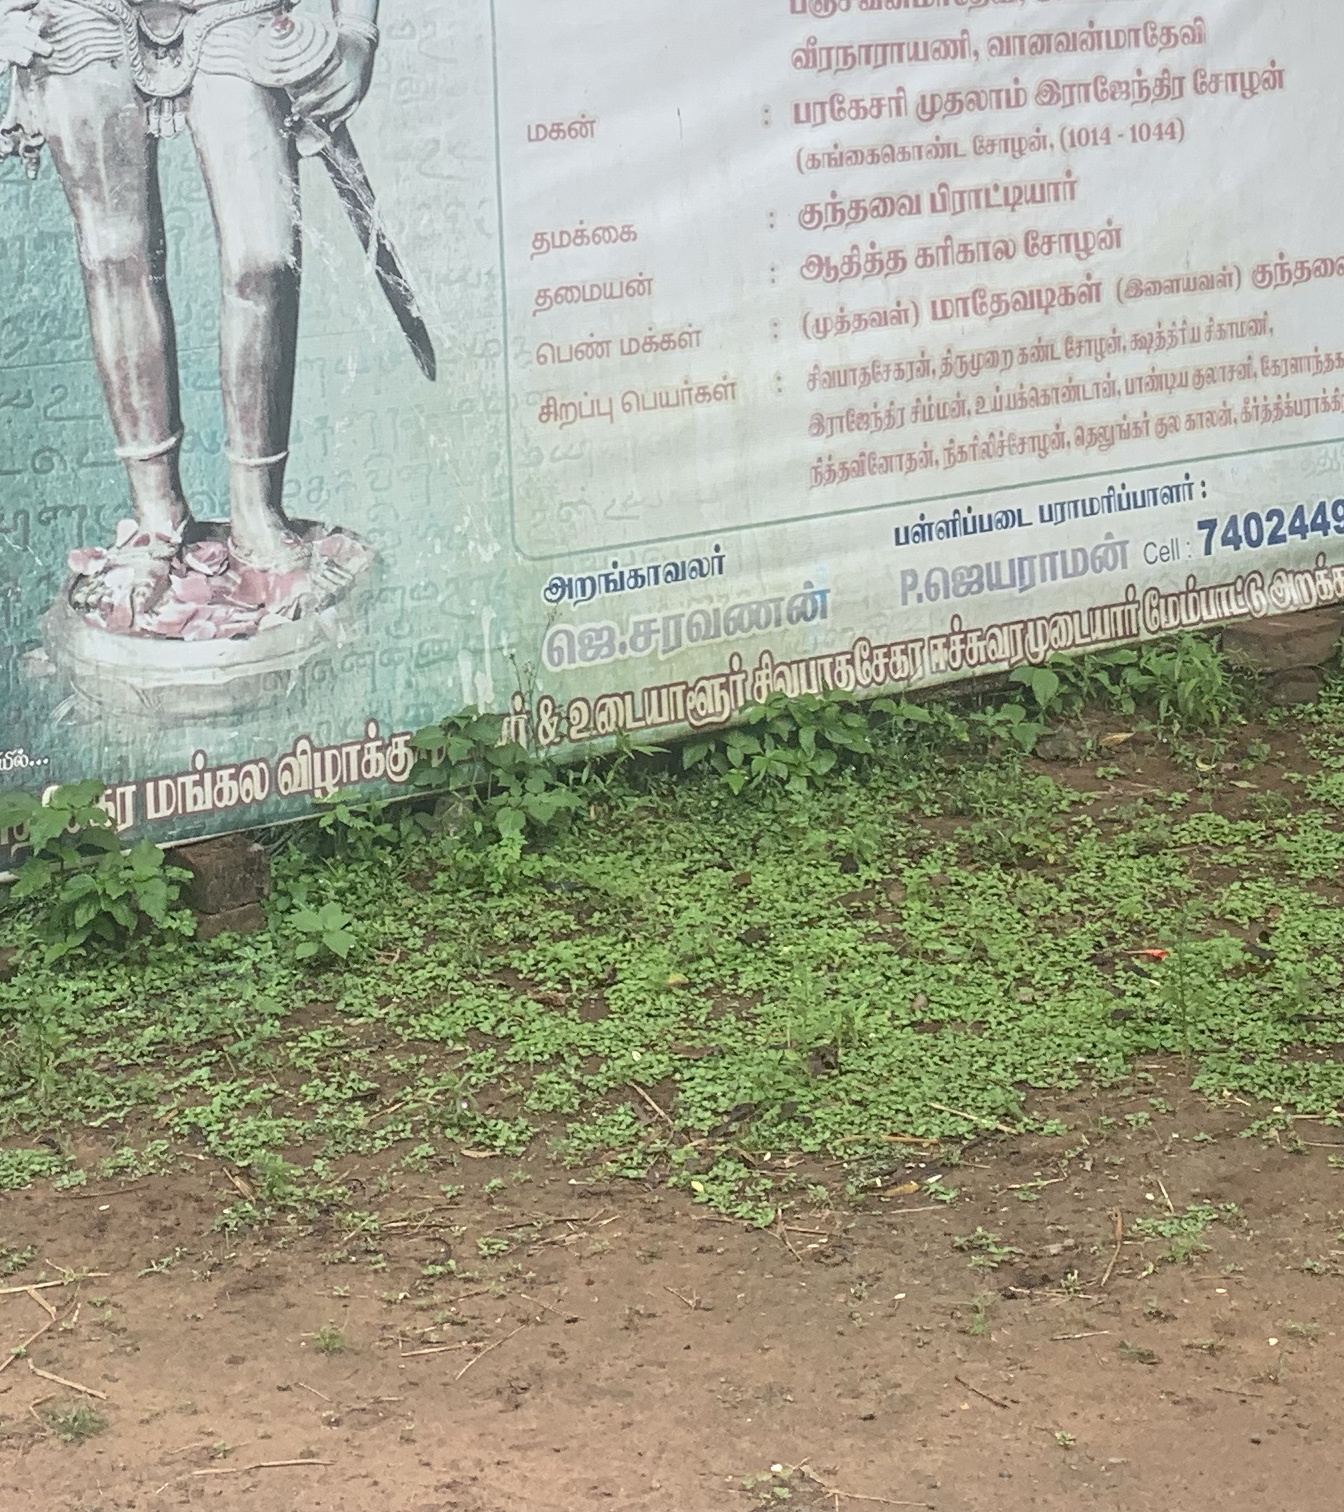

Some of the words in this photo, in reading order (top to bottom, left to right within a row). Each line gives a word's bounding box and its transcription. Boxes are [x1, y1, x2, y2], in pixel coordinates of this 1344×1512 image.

[791, 28, 981, 74] வீரநாராயணி,
[987, 16, 1207, 64] வானவன்மாதேவி
[527, 113, 597, 143] மகன்
[793, 86, 908, 128] பரகேசரி
[915, 78, 1028, 123] முதலாம்
[1034, 68, 1187, 108] இராஜேந்திர
[1192, 59, 1286, 99] சோழன்
[796, 135, 967, 175] (கங்கைகொண்ட
[973, 127, 1054, 160] சோழன்,
[1059, 125, 1113, 152] (1014
[1130, 117, 1186, 146] 1044)
[530, 219, 638, 260] தமக்கை
[798, 190, 923, 231] குந்தவை
[929, 170, 1079, 218] பிராட்டியார்
[533, 272, 654, 316] தமையன்
[799, 239, 909, 284] ஆதித்த
[913, 232, 1018, 271] கரிகால
[1023, 218, 1124, 258] சோழன்
[536, 332, 613, 367] பெண்
[618, 323, 703, 357] மக்கள்
[929, 272, 1103, 324] மாதேவடிகள்
[537, 391, 614, 430] சிறப்பு
[620, 375, 739, 415] பெயர்கள்
[1017, 337, 1061, 364] கண்ட
[808, 400, 906, 438] இராஜேந்திர
[1124, 366, 1189, 397] பாண்டிய
[893, 504, 1033, 548] பள்ளிப்படை
[543, 544, 727, 606] அறங்காவலர்
[545, 580, 832, 669] ஜெ.சரவணன்
[145, 749, 272, 818] மங்கல
[536, 694, 562, 745] &
